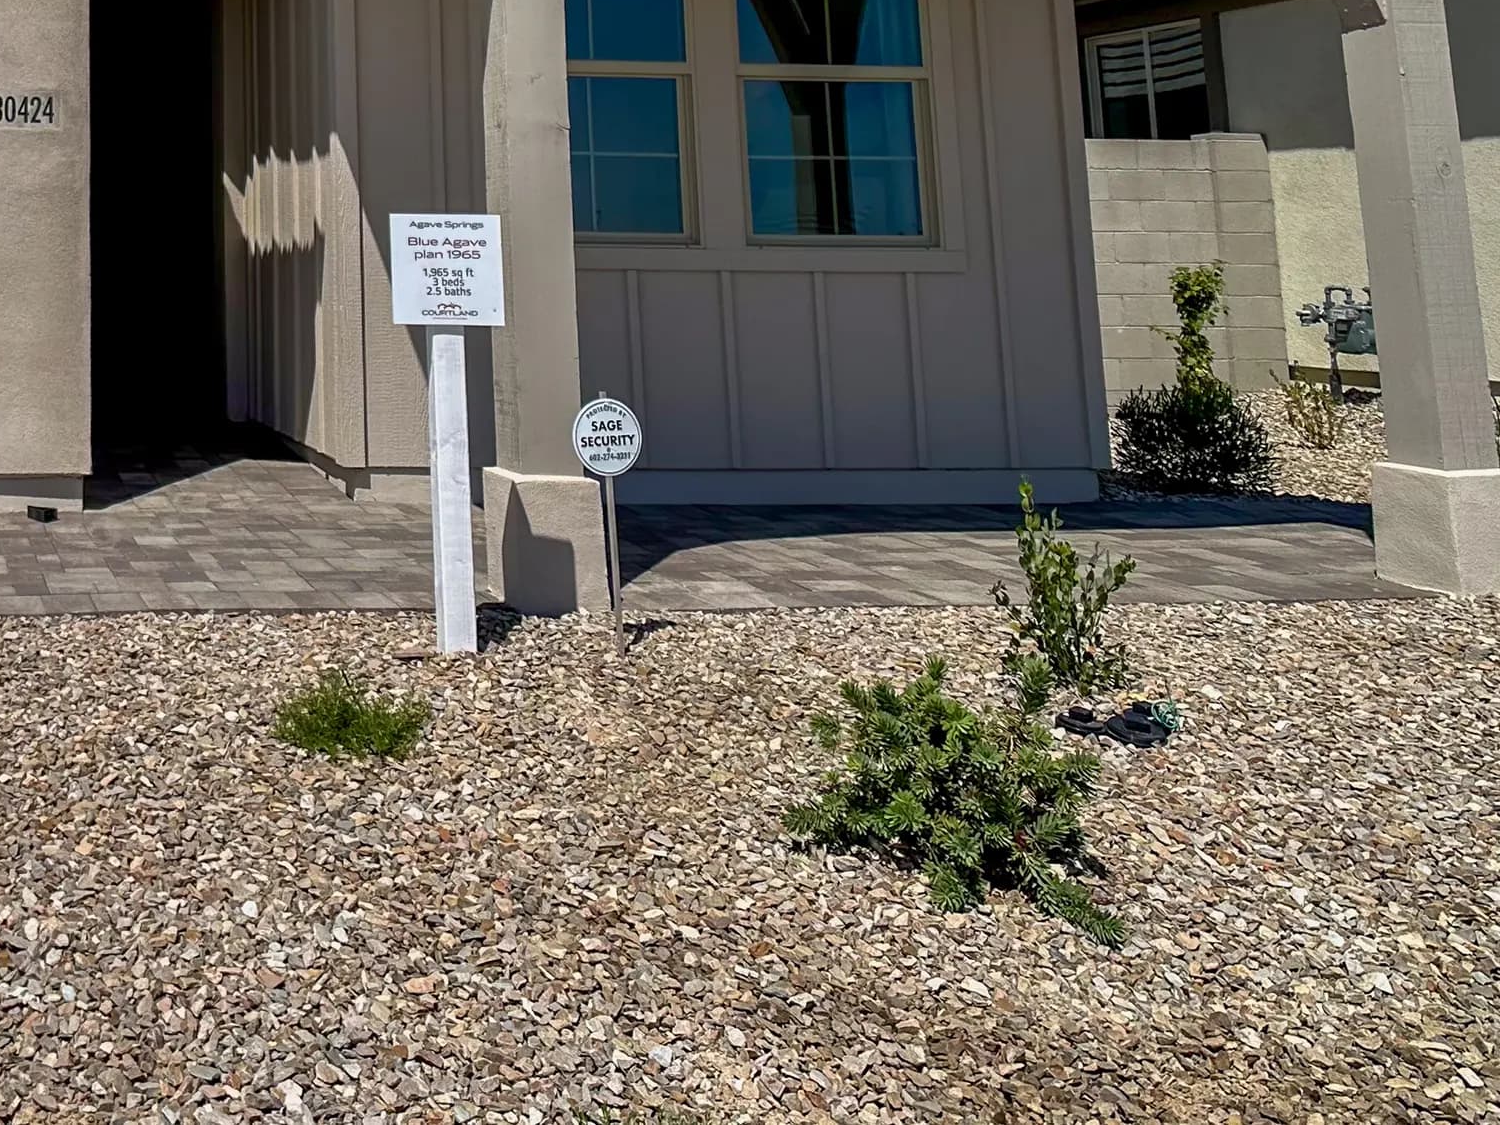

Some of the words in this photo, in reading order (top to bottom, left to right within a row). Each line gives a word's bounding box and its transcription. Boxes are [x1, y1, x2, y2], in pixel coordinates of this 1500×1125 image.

[409, 221, 443, 230] Agave
[444, 221, 484, 230] Springs
[407, 237, 438, 247] Blue
[442, 237, 487, 249] Agave
[414, 249, 443, 261] plan
[447, 250, 481, 260] 1965
[422, 268, 449, 278] 1,965
[451, 269, 463, 279] sq
[465, 268, 474, 277] ft
[432, 278, 439, 286] 3
[441, 277, 465, 287] beds
[426, 287, 442, 296] 2.5
[444, 287, 472, 296] baths
[591, 420, 623, 432] SAGE
[581, 434, 635, 448] SECURITY
